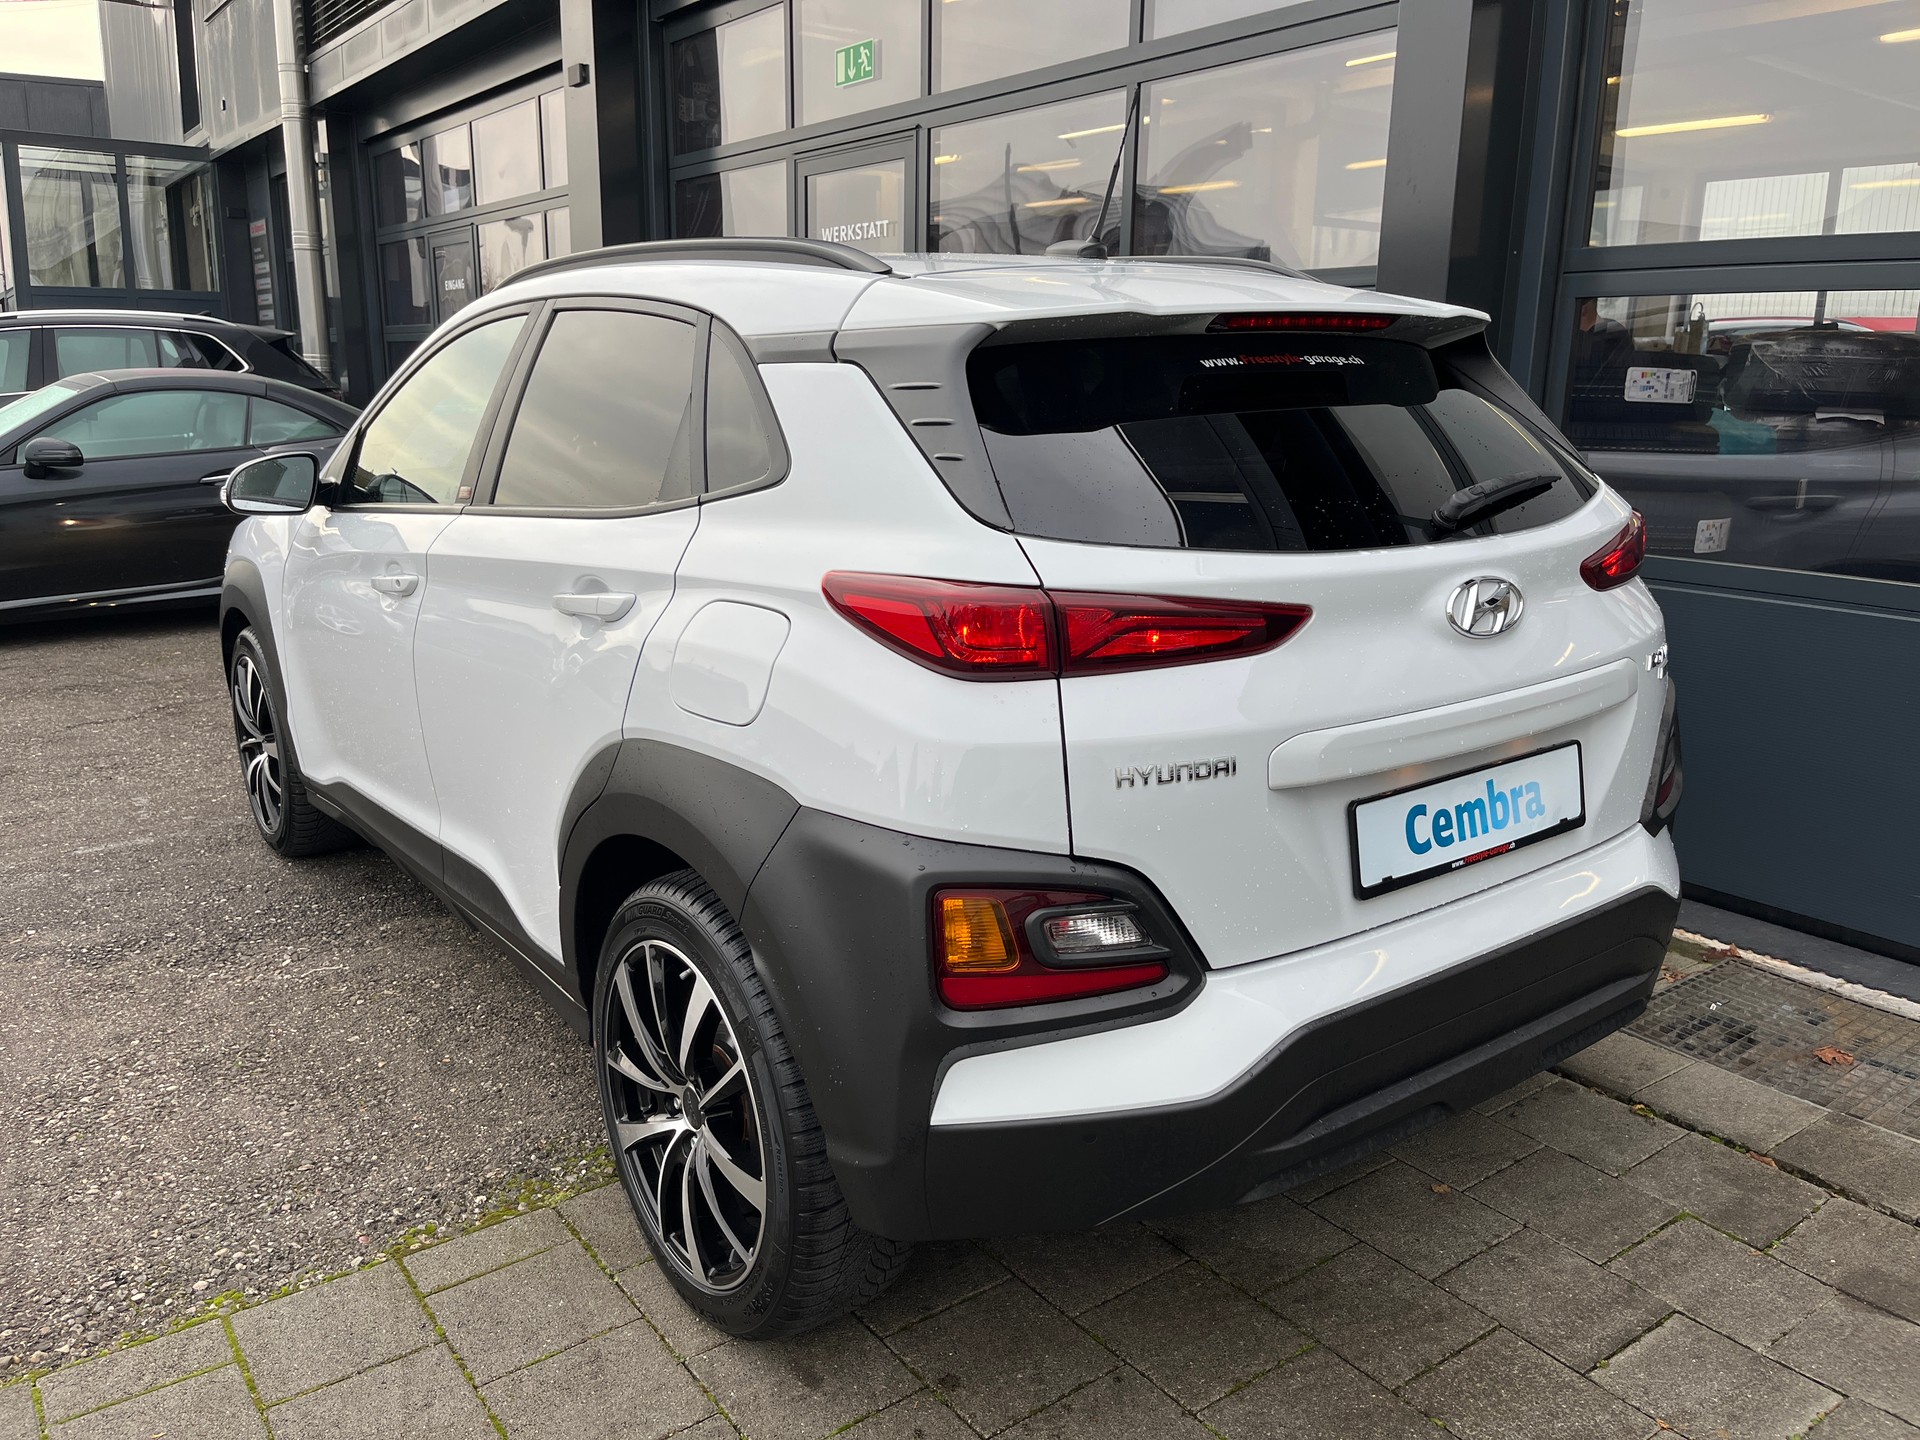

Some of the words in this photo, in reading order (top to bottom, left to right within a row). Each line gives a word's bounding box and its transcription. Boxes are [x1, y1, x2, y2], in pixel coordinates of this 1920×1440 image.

[821, 220, 889, 242] WERKSTATT
[445, 279, 464, 291] EINGANG
[1200, 354, 1365, 368] www.Freestyle-garage.ch
[1115, 755, 1236, 790] HYUNDAI
[1405, 778, 1546, 855] Cembra
